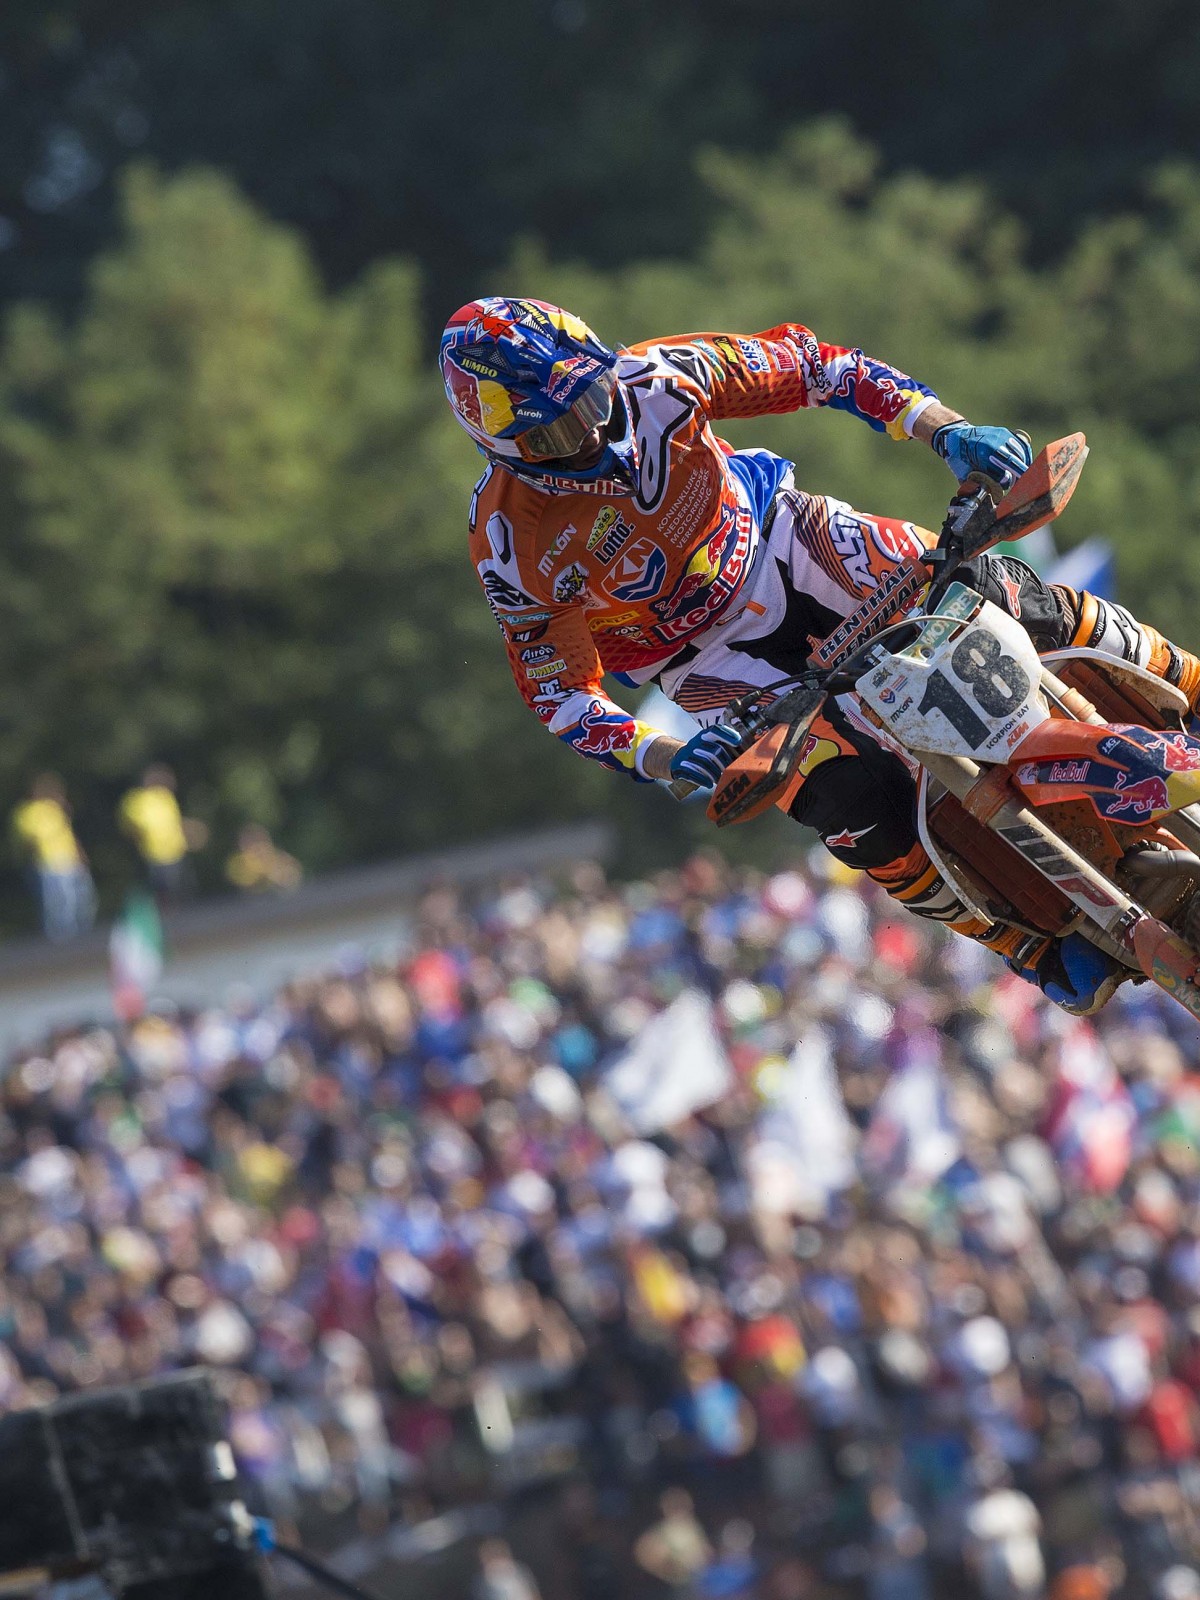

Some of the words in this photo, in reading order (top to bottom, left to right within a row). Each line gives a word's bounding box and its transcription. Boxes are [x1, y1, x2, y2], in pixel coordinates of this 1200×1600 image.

[461, 357, 498, 378] JUMBO
[552, 374, 577, 404] Red
[572, 356, 603, 378] Bull
[516, 408, 543, 420] Airoh
[656, 468, 699, 533] KONINKLIJKE
[670, 468, 710, 544] MOTORRIJDERS
[676, 487, 712, 549] VERENIGING
[655, 579, 731, 640] Red
[719, 507, 752, 588] Bull
[816, 563, 915, 663] RENTHAL
[831, 575, 925, 669] RENTHAL
[521, 645, 555, 661] Airoh
[528, 662, 564, 677] JMBO
[917, 629, 1031, 751] 18
[986, 717, 1017, 750] SCORPION
[1016, 704, 1031, 720] BAY
[1007, 721, 1030, 748] KTM
[713, 772, 751, 815] KTM
[1048, 762, 1068, 782] Red
[1067, 760, 1092, 781] Bull
[927, 879, 942, 895] XIII
